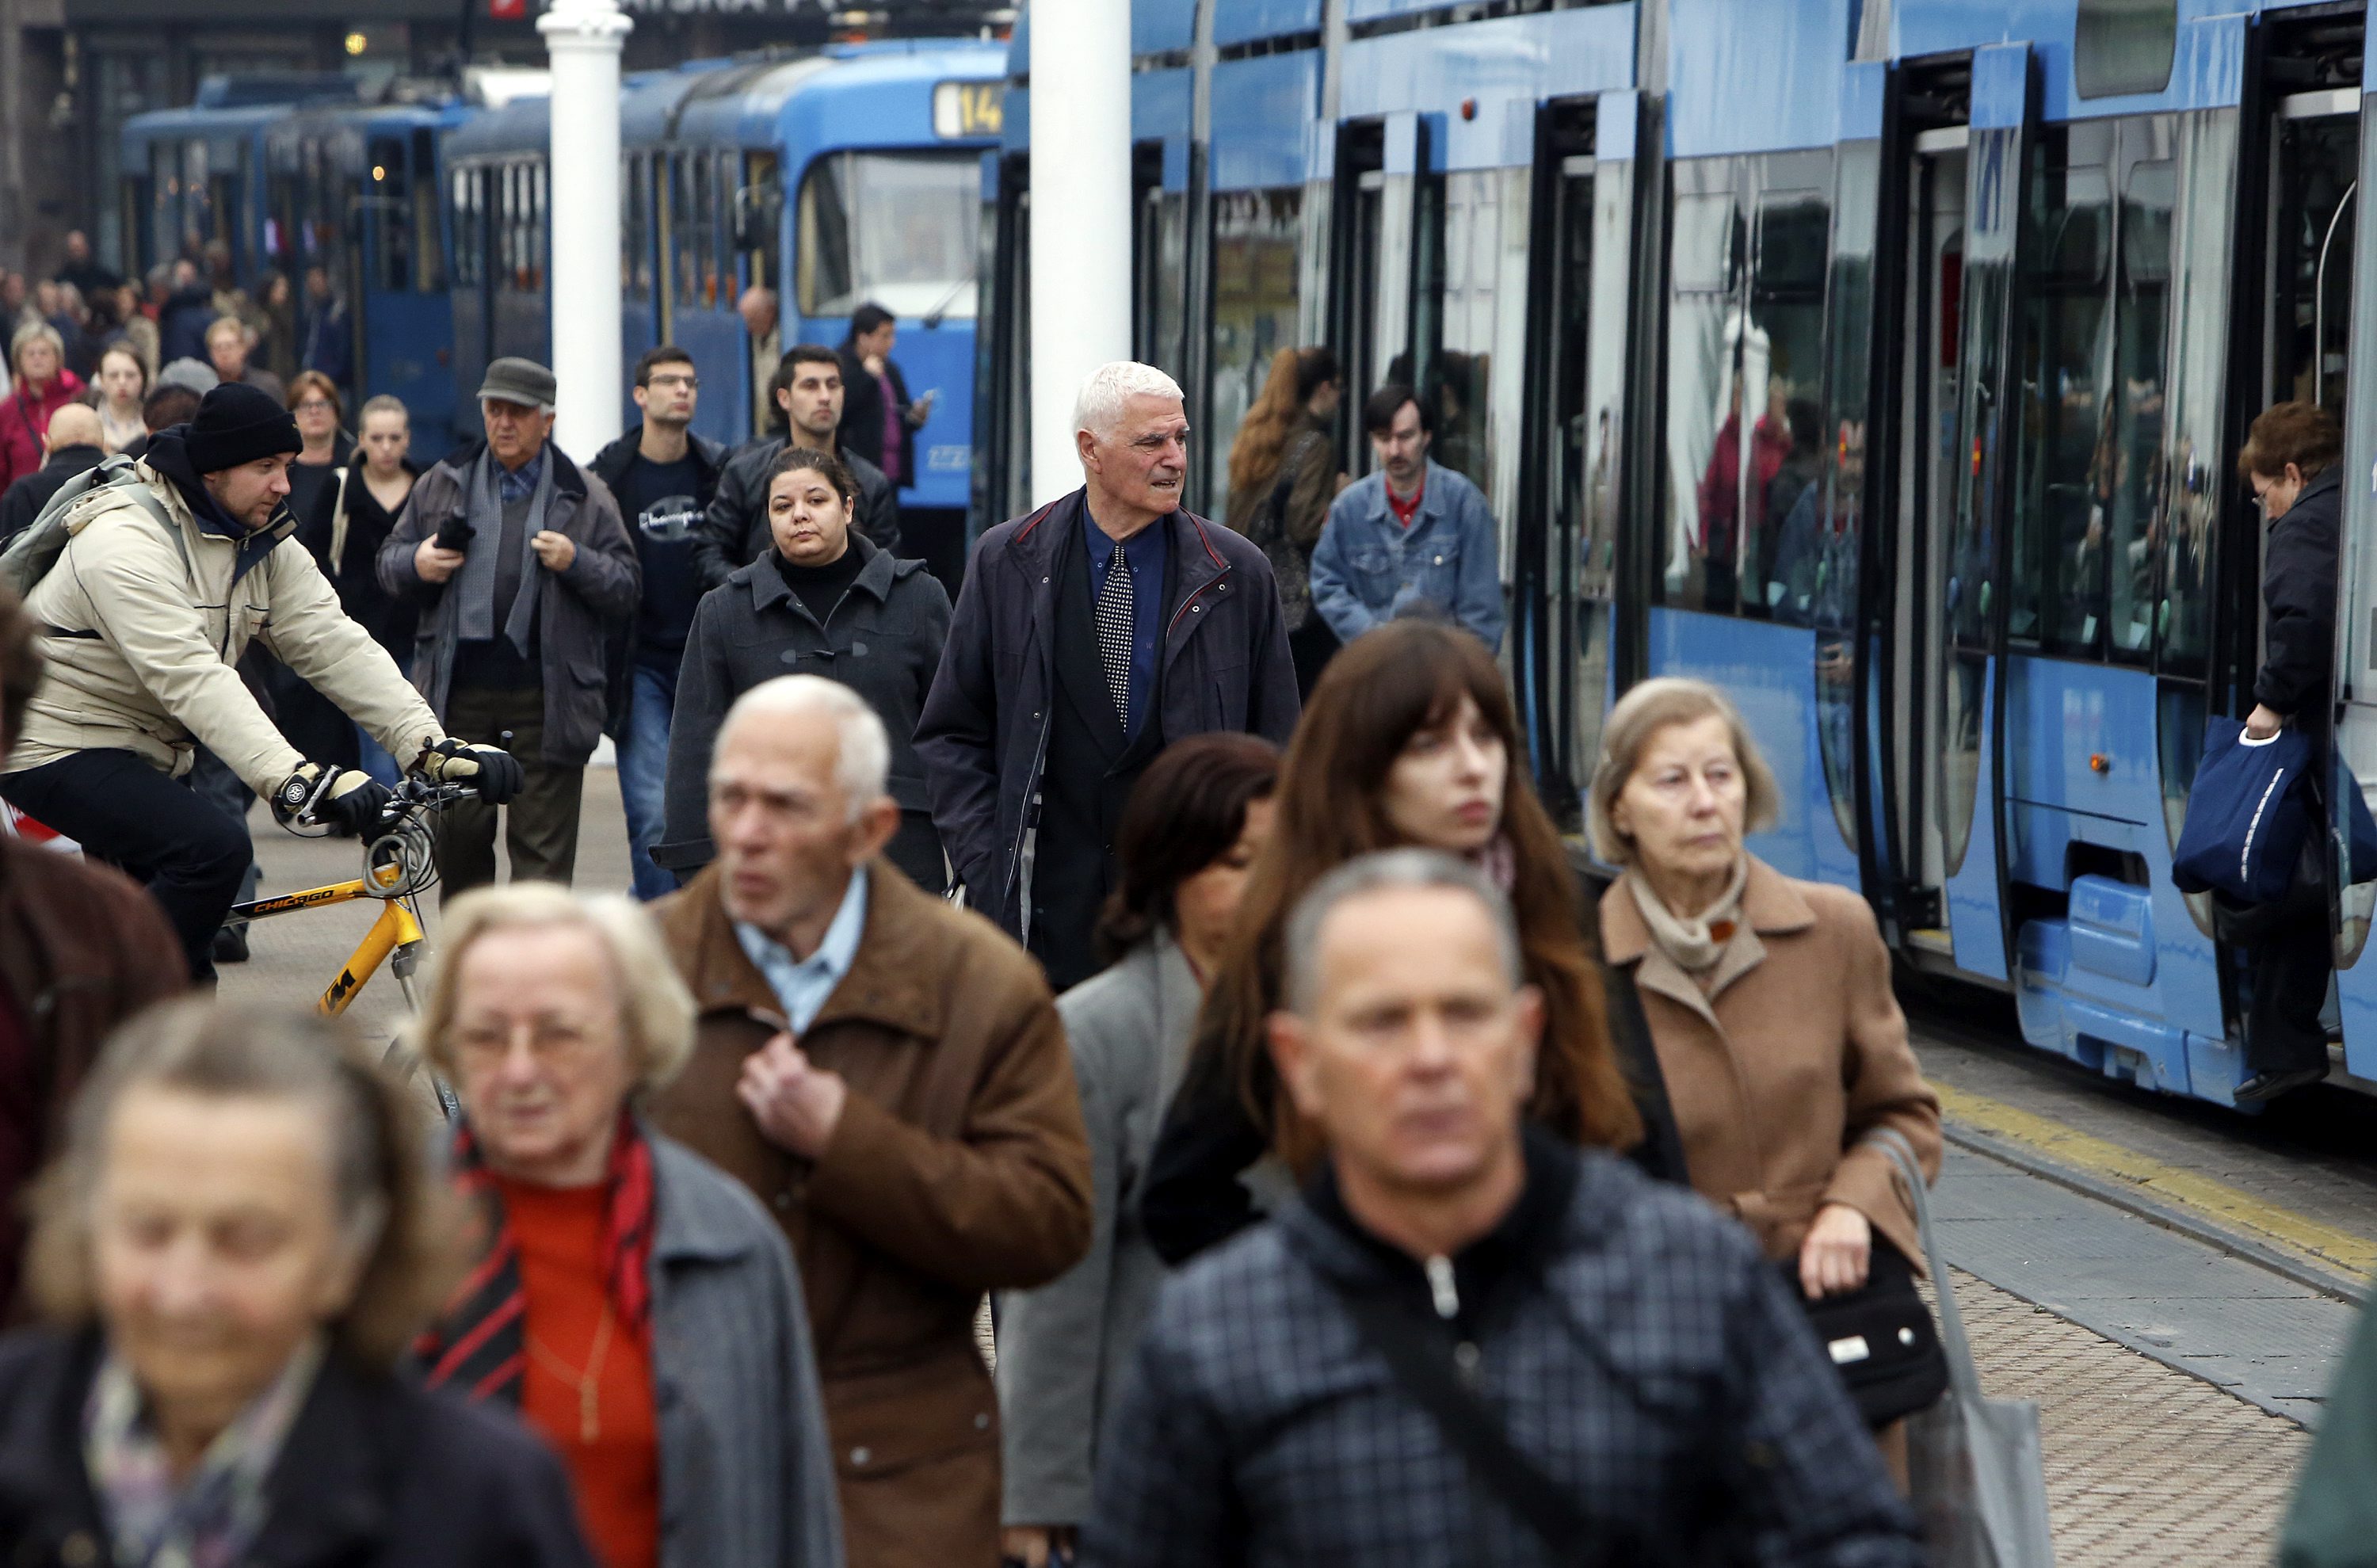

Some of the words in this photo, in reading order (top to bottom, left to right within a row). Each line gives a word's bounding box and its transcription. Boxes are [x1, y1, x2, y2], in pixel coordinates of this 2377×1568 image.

[960, 84, 1002, 134] 14
[638, 509, 705, 529] Champio
[254, 889, 334, 914] CHICAGO
